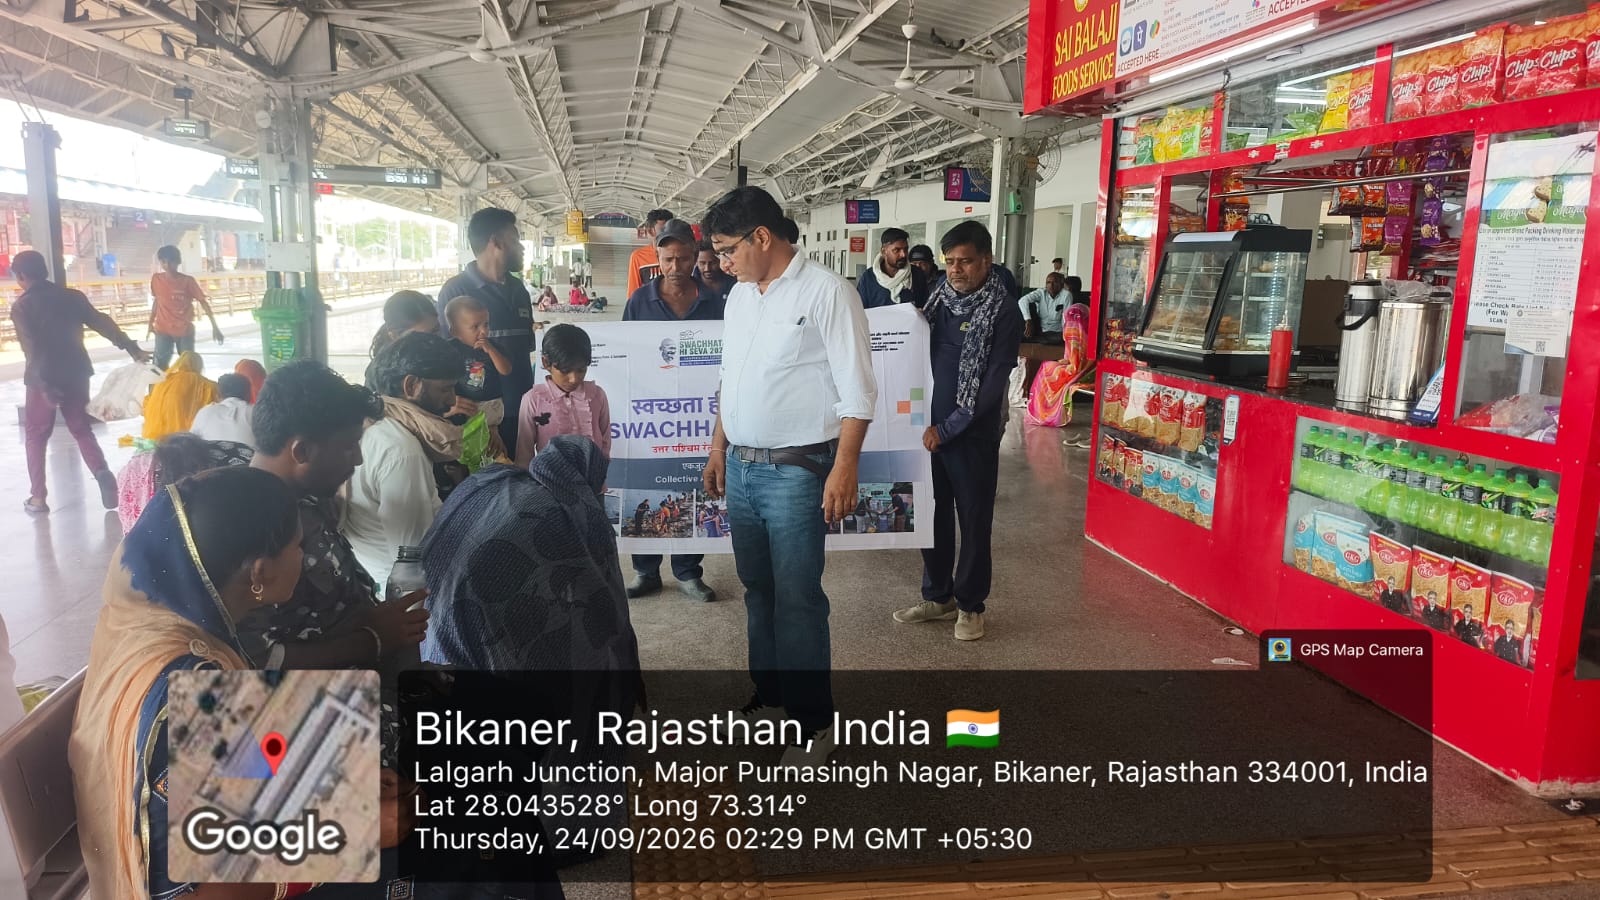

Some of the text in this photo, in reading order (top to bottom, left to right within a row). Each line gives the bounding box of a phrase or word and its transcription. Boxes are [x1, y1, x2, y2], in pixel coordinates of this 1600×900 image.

[1267, 0, 1311, 16] ACCEPT
[1055, 25, 1073, 67] SAI
[1074, 2, 1118, 59] BALAJI
[1118, 48, 1160, 73] ACCEPTED HERE
[1540, 47, 1578, 70] Chips
[1052, 52, 1115, 101] FOODS SERVICE
[1461, 62, 1492, 83] Chips
[1505, 58, 1539, 79] Chips
[1392, 82, 1418, 100] Chips
[1427, 72, 1457, 93] Chips
[1349, 92, 1371, 111] Chip
[135, 212, 144, 221] 2
[1490, 301, 1510, 309] Check
[679, 339, 722, 348] SWACHHAT
[689, 347, 708, 355] SEVA
[709, 346, 722, 354] 202
[631, 397, 703, 415] स्वच्छता
[610, 419, 714, 439] SWACHH
[651, 445, 669, 454] उत्तर
[671, 442, 700, 453] पश्चिम
[655, 475, 699, 483] Collective
[1325, 534, 1336, 545] GK
[1344, 552, 1361, 565] GKG
